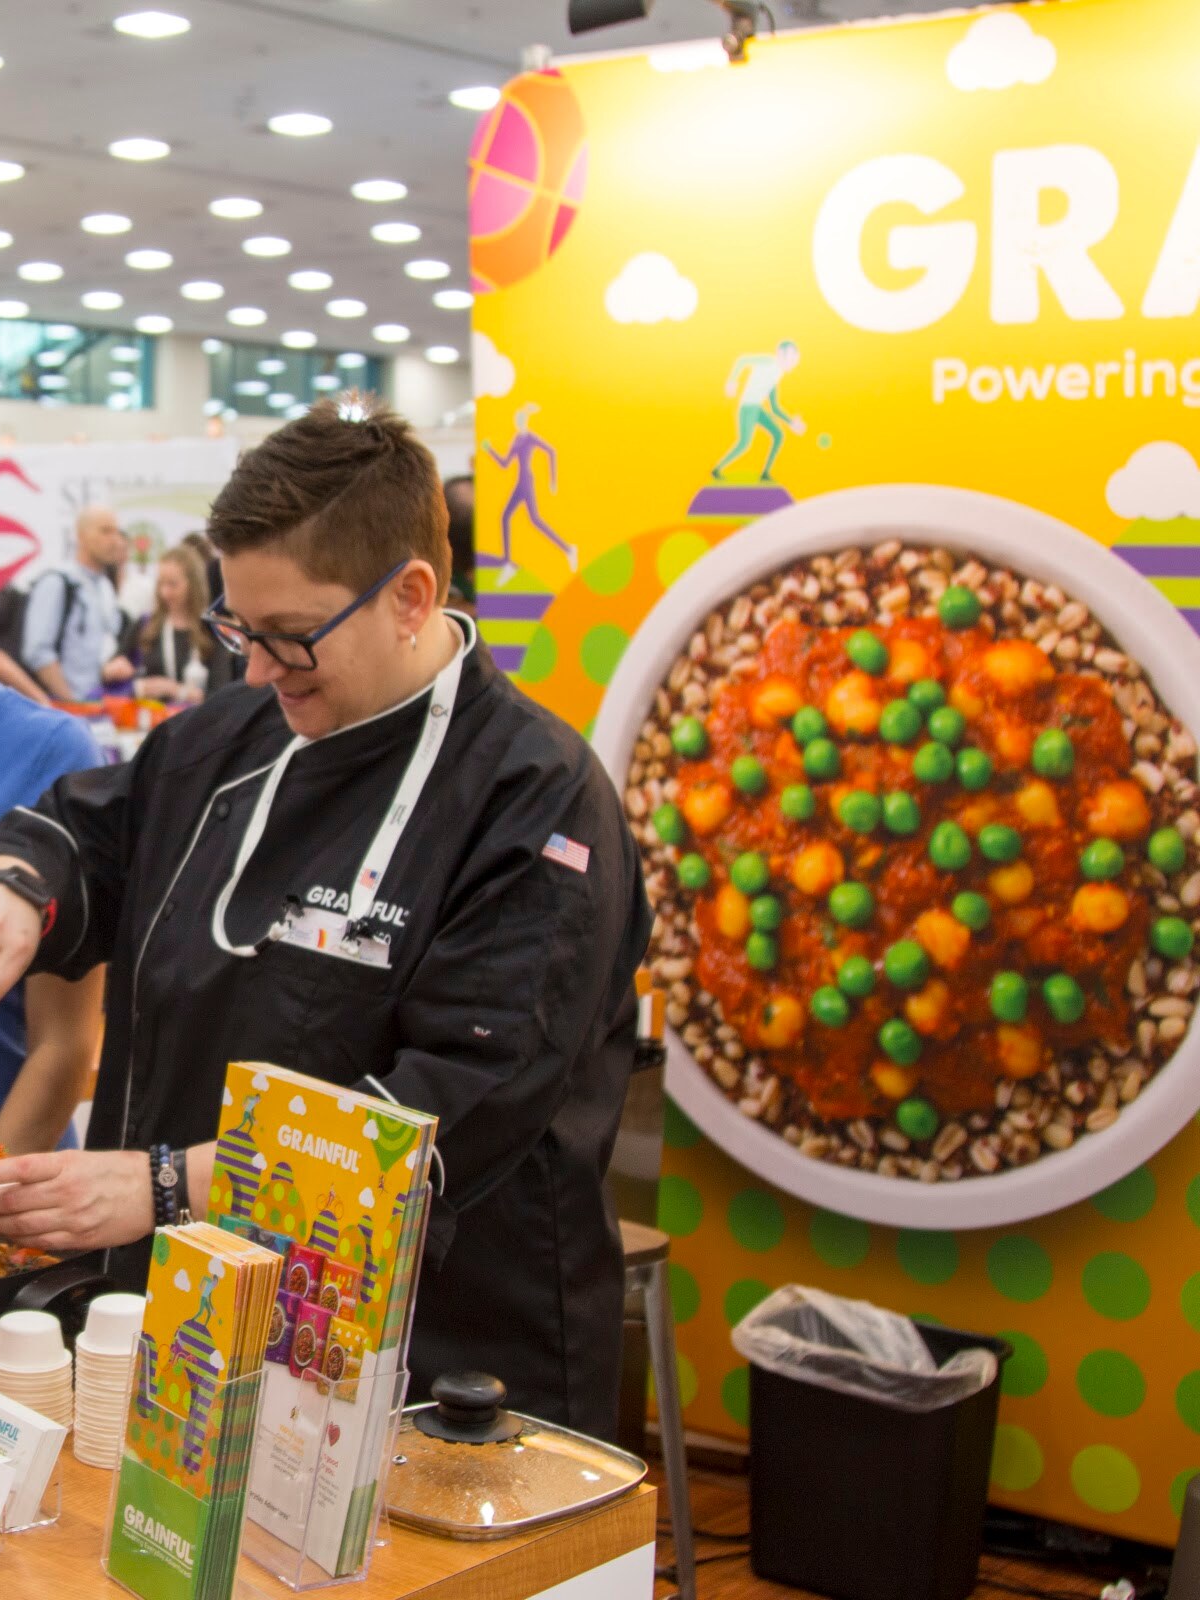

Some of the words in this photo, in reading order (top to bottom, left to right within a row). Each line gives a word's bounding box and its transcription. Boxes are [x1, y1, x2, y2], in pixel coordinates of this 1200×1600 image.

[306, 884, 406, 927] GRAFUL
[277, 1124, 359, 1174] GRAINFUL
[123, 1504, 195, 1566] GRAINFUL
